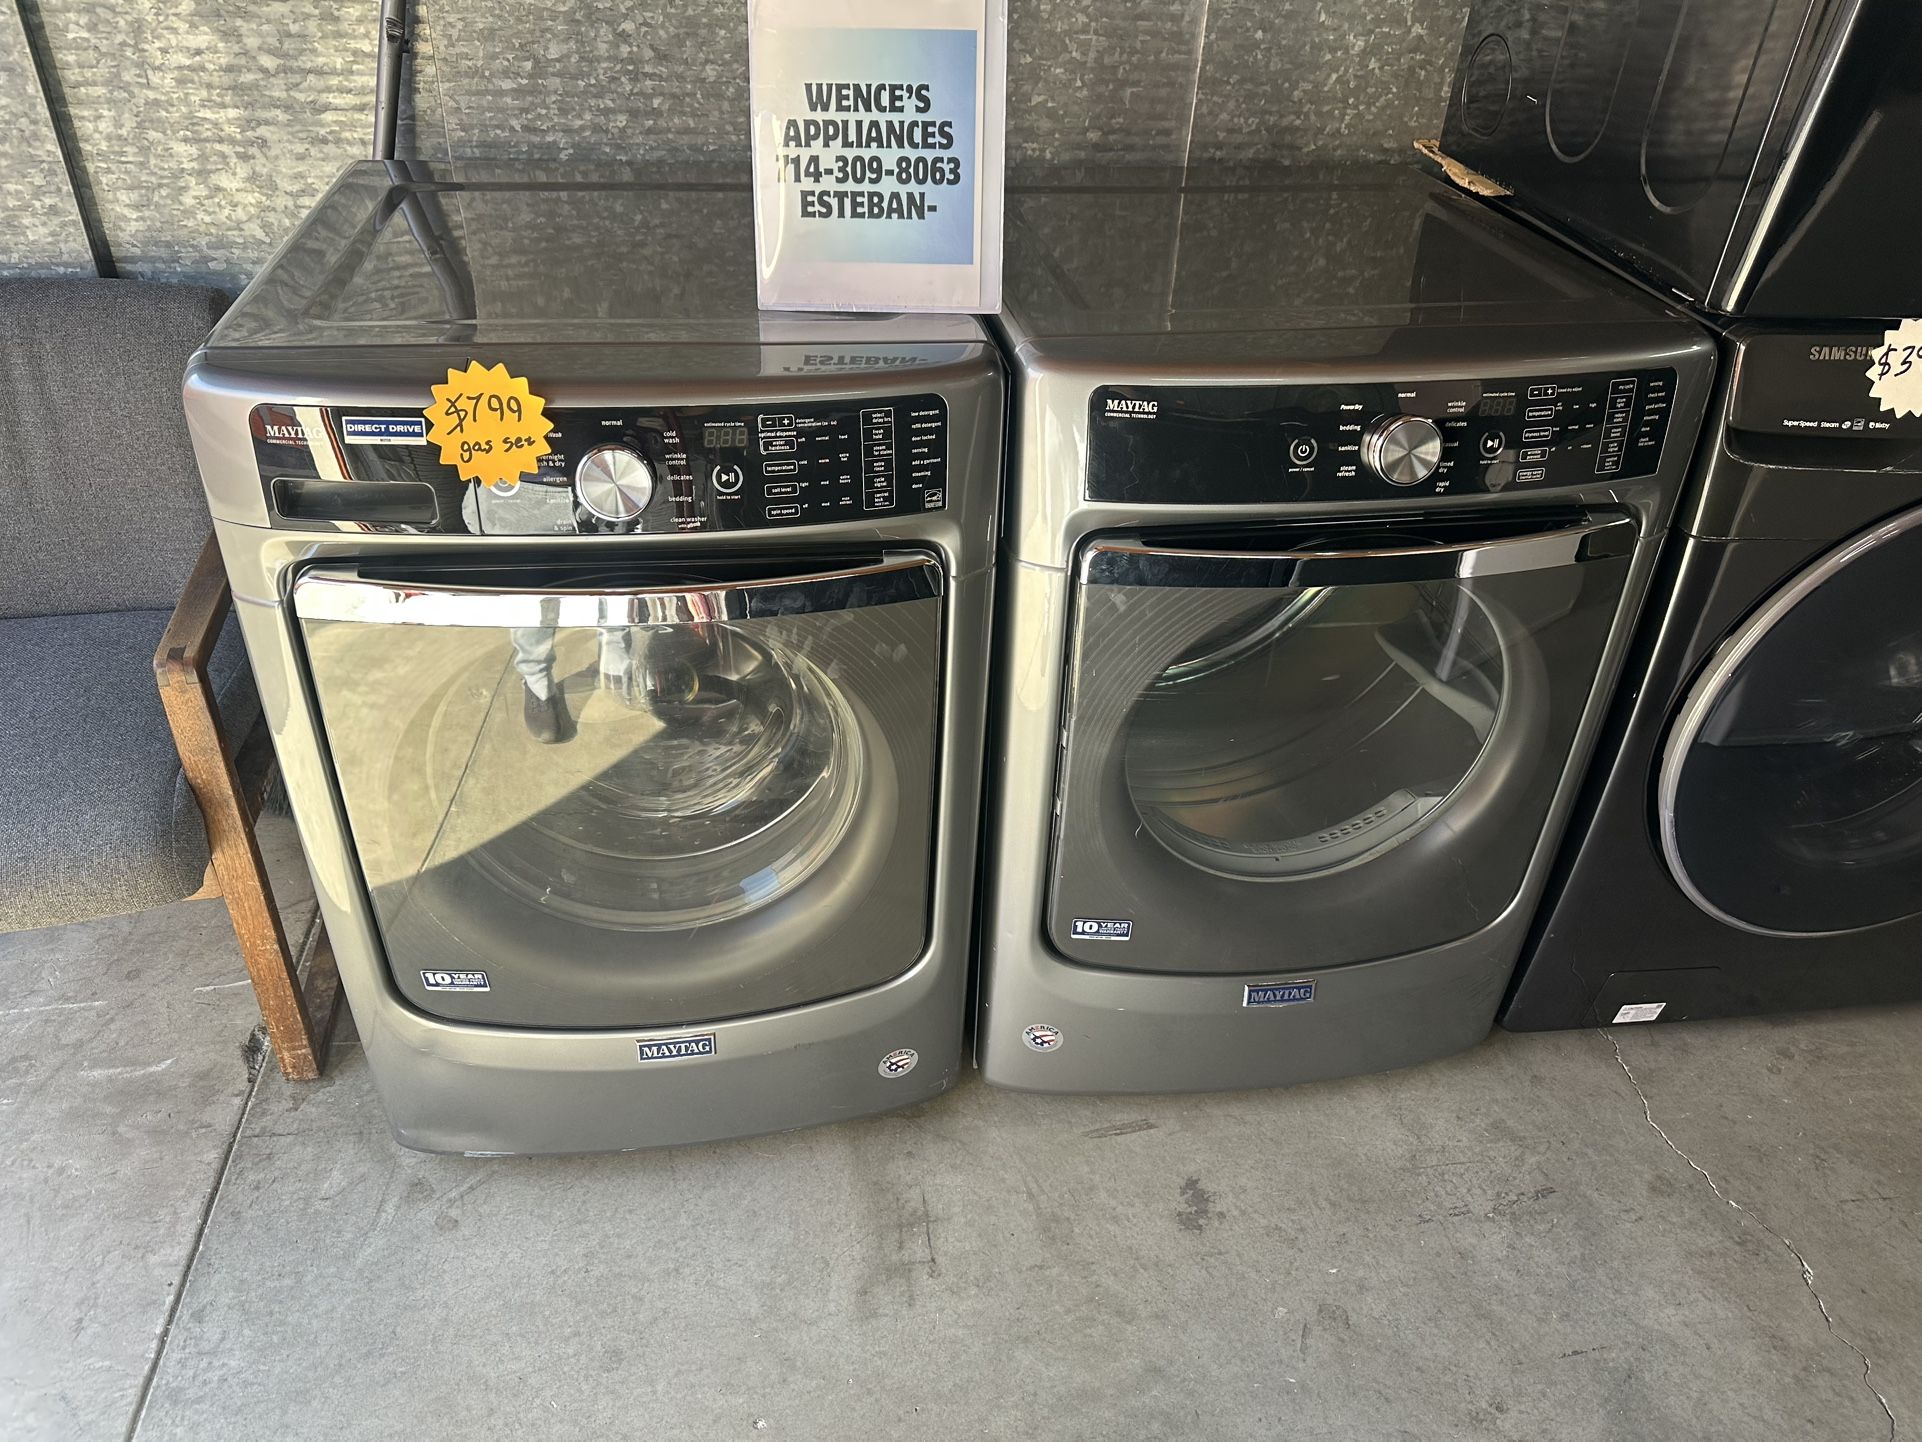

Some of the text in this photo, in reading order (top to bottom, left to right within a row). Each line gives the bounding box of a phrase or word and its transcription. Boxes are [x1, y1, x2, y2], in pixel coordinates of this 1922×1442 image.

[804, 82, 931, 113] WENCE'S
[783, 118, 954, 150] APPLIANCES
[776, 154, 961, 185] 714-309-8063
[800, 190, 938, 220] ESTEBAN-
[1809, 346, 1875, 361] SAMSUN
[1105, 399, 1158, 413] MAYTAG
[444, 392, 523, 436] $799
[347, 424, 422, 433] DIRECT DRIVE
[1783, 419, 1818, 428] SuperSpeed
[460, 437, 493, 463] gas
[1075, 921, 1099, 933] 10
[424, 972, 452, 985] 10
[1250, 988, 1311, 1003] MAYTAG
[1025, 1024, 1059, 1037] AMERICA
[641, 1039, 710, 1060] MAYTAG
